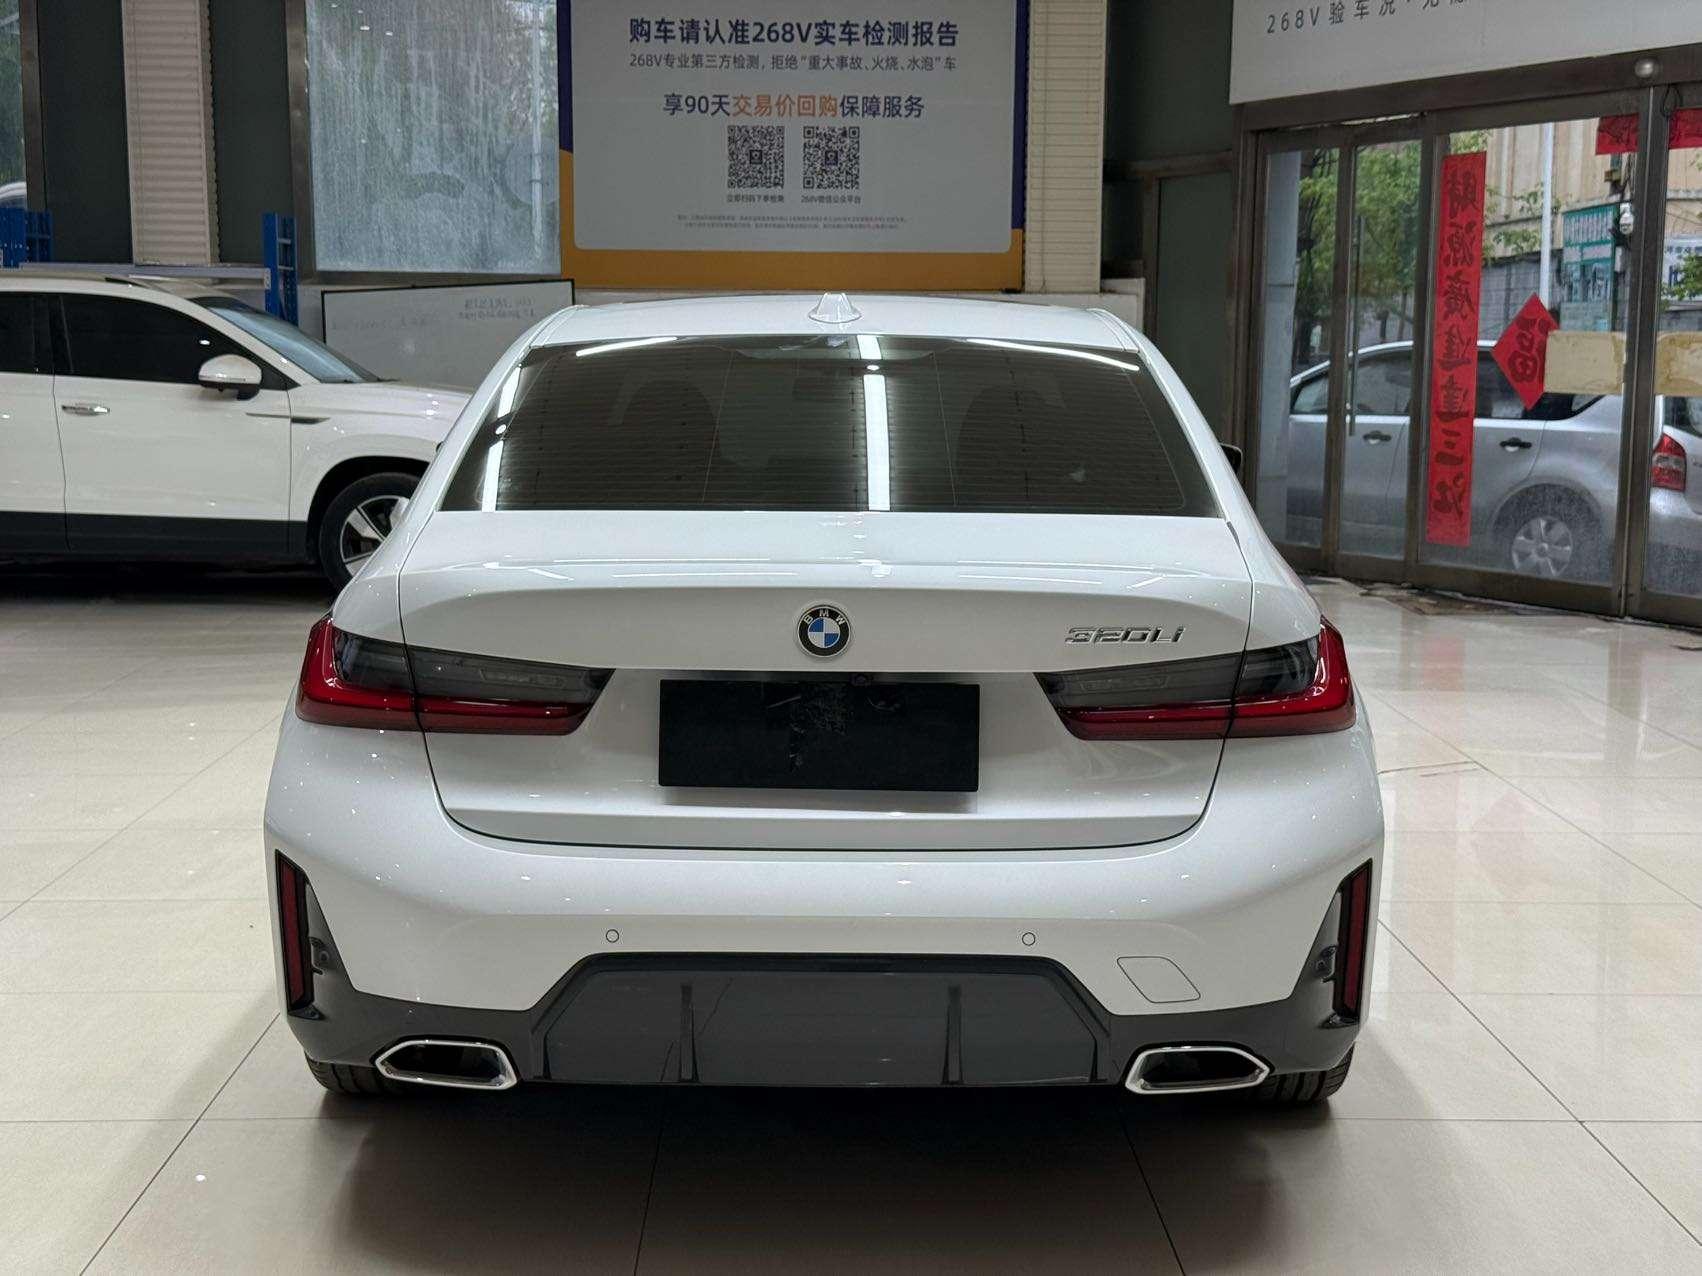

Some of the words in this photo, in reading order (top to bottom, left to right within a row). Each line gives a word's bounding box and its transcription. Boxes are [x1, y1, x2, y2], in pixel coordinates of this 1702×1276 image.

[629, 18, 959, 47] 购车请认准268V实车检测报告
[663, 93, 925, 119] 享90天交易价回购保障服务
[1064, 626, 1185, 644] 320Li
